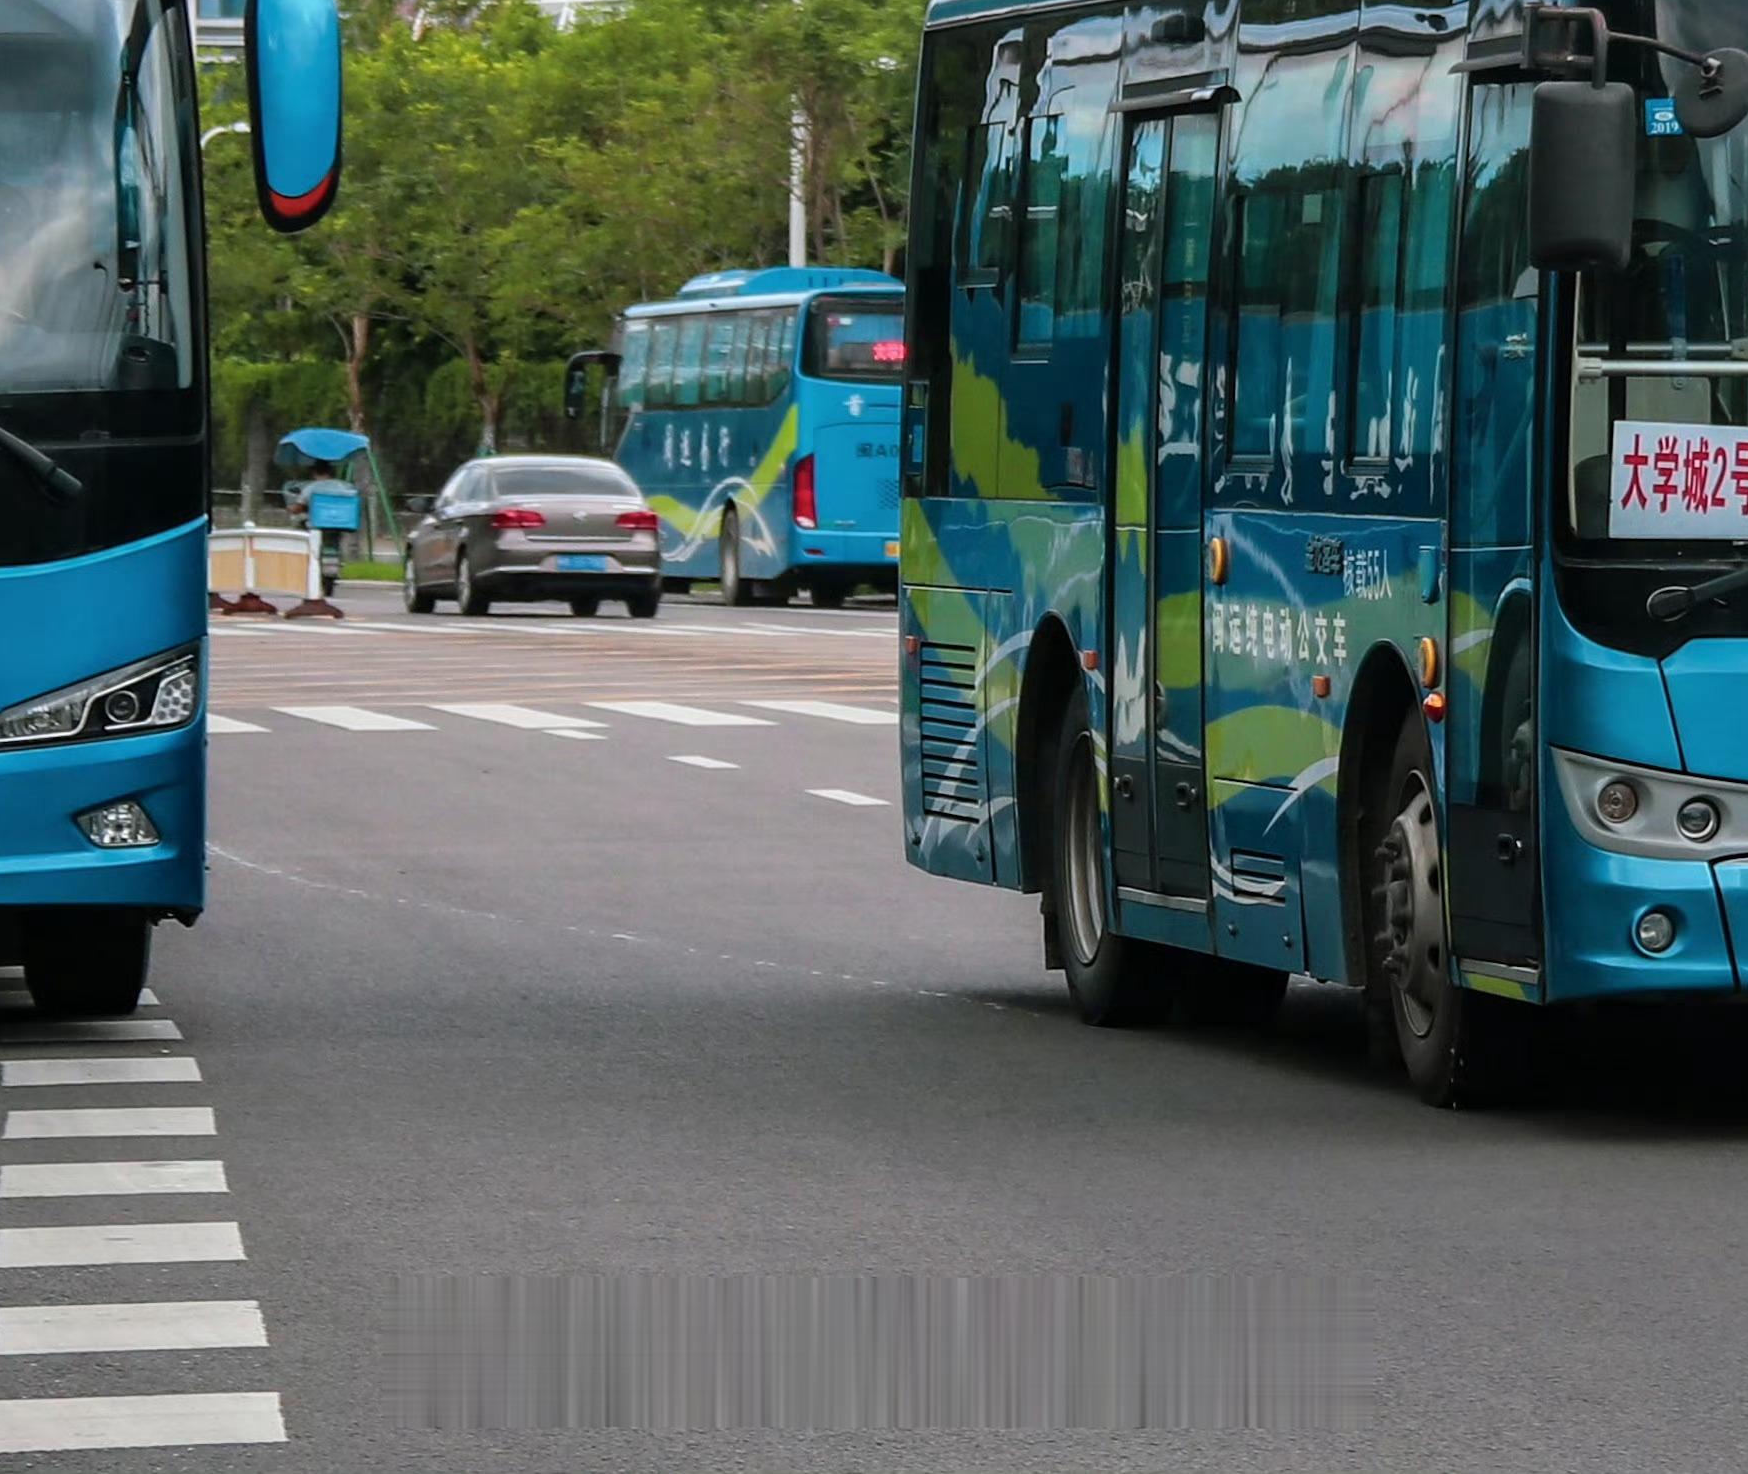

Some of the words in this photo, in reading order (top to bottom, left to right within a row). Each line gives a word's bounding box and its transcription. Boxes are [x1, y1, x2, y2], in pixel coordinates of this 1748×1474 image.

[1650, 122, 1680, 134] 2019
[1342, 549, 1392, 600] 核载55人
[1212, 602, 1348, 666] 闽运纯电动公交车
